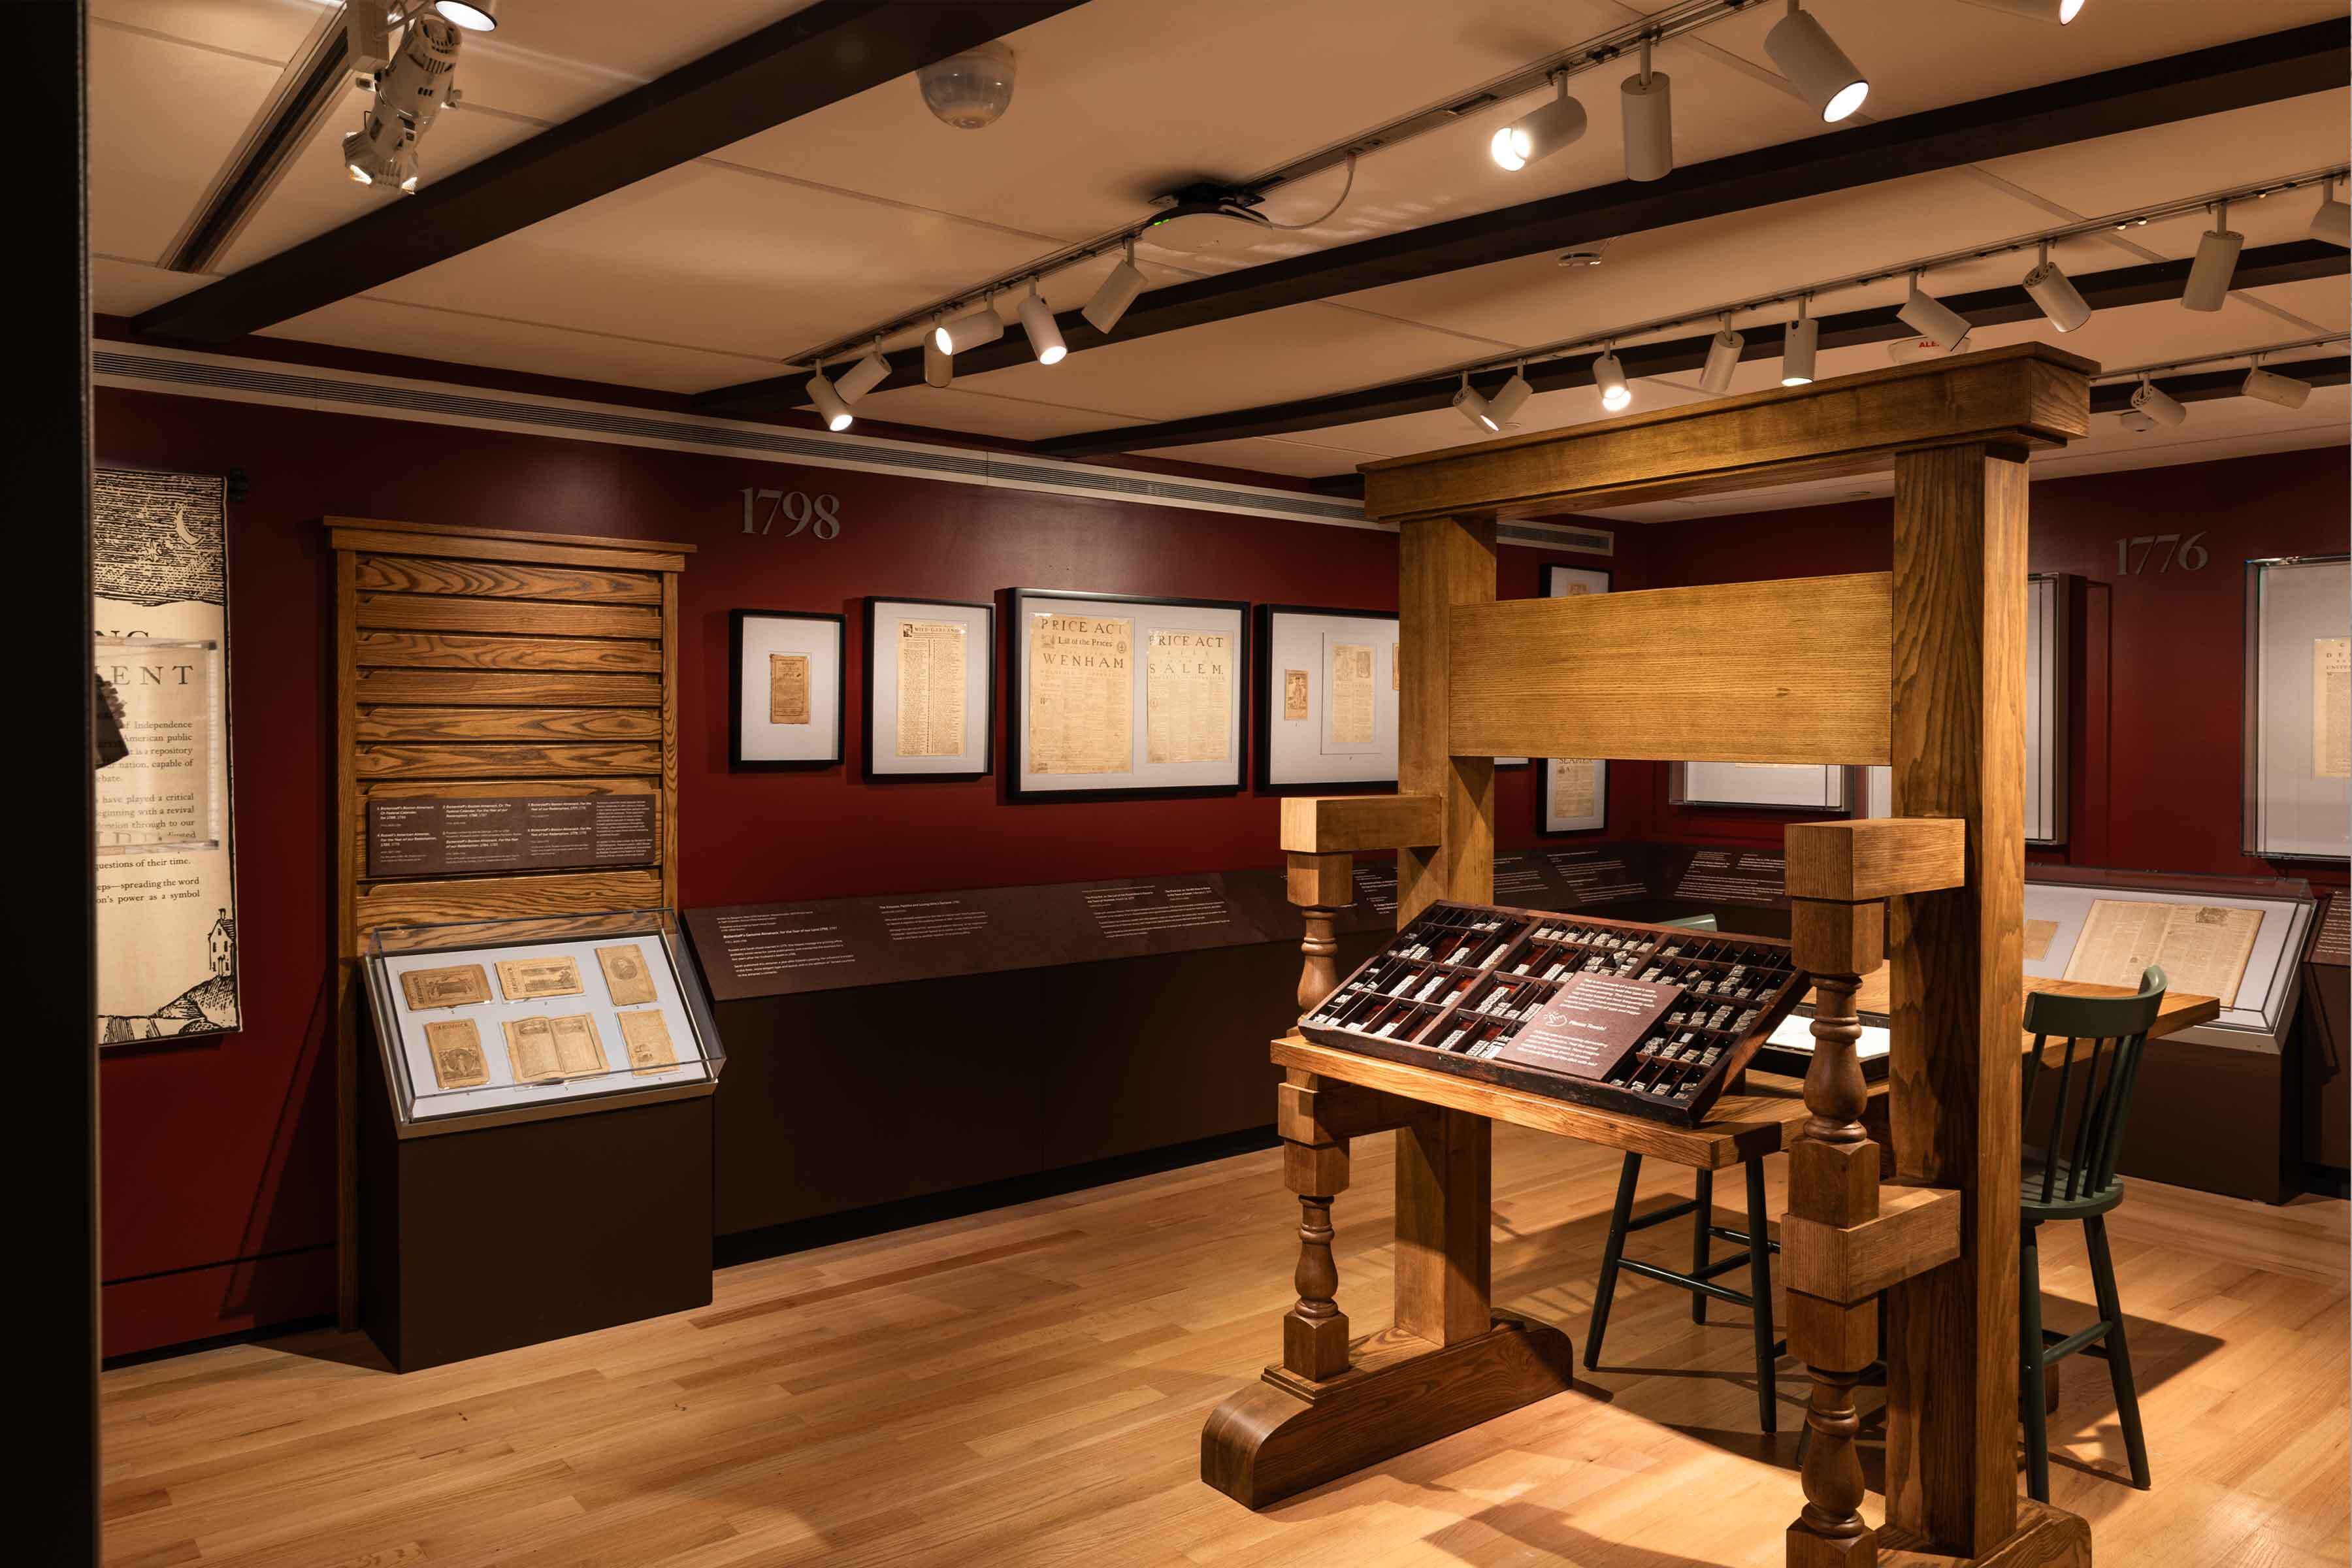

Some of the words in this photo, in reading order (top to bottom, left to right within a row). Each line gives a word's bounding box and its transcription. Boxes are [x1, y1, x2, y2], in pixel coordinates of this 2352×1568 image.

[739, 487, 840, 540] 1798
[2114, 531, 2208, 576] 1776
[1041, 618, 1088, 633] PRICE
[1094, 622, 1124, 635] ACT
[1195, 637, 1224, 648] ACT
[1043, 653, 1124, 668] WENHAM
[97, 665, 193, 685] ENT
[135, 721, 193, 730] Independence
[167, 732, 193, 743] public
[151, 747, 193, 757] repository
[152, 759, 183, 770] capable
[184, 759, 194, 768] of
[126, 794, 155, 805] played
[166, 793, 195, 802] critical
[167, 806, 194, 815] revival
[131, 820, 166, 830] through
[135, 859, 146, 868] of
[147, 858, 167, 867] their
[170, 857, 191, 866] time.
[97, 880, 162, 893] eps—spreading
[163, 879, 176, 887] the
[178, 877, 200, 886] word
[118, 895, 144, 905] power
[170, 890, 200, 901] symbol
